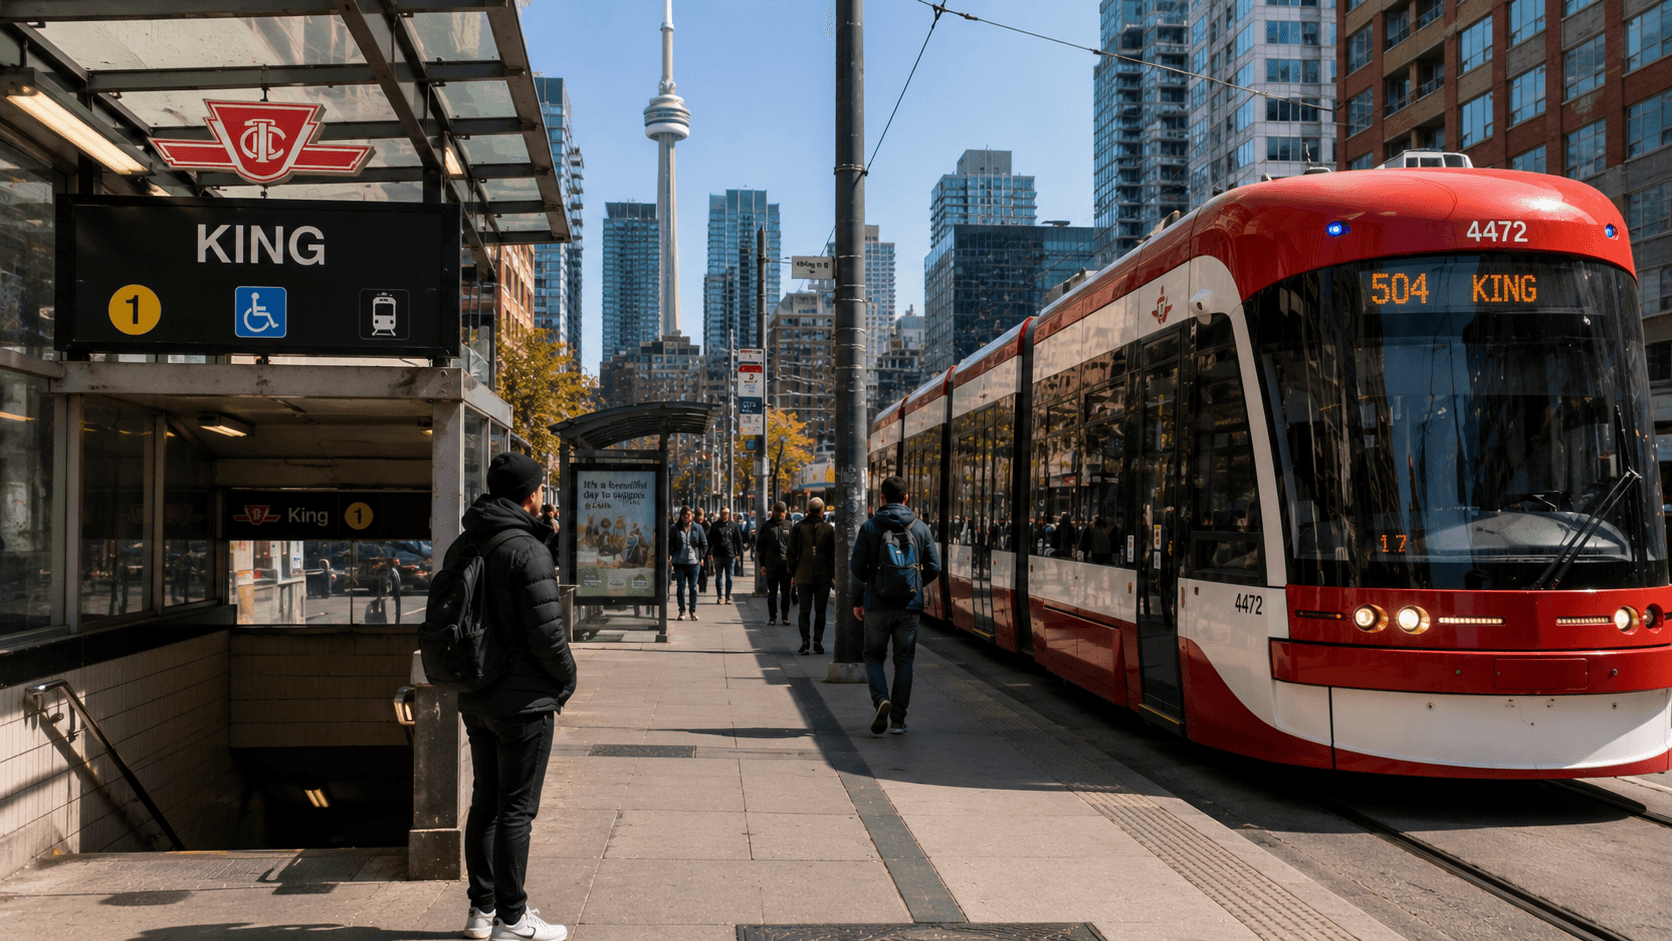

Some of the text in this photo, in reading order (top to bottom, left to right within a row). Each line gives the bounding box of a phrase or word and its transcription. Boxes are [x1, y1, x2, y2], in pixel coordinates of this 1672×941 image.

[197, 224, 325, 266] KING
[1466, 220, 1528, 243] 4472
[1371, 272, 1537, 305] 504 KING
[125, 294, 140, 325] 1
[288, 507, 363, 527] King 1
[1234, 592, 1263, 616] 4472
